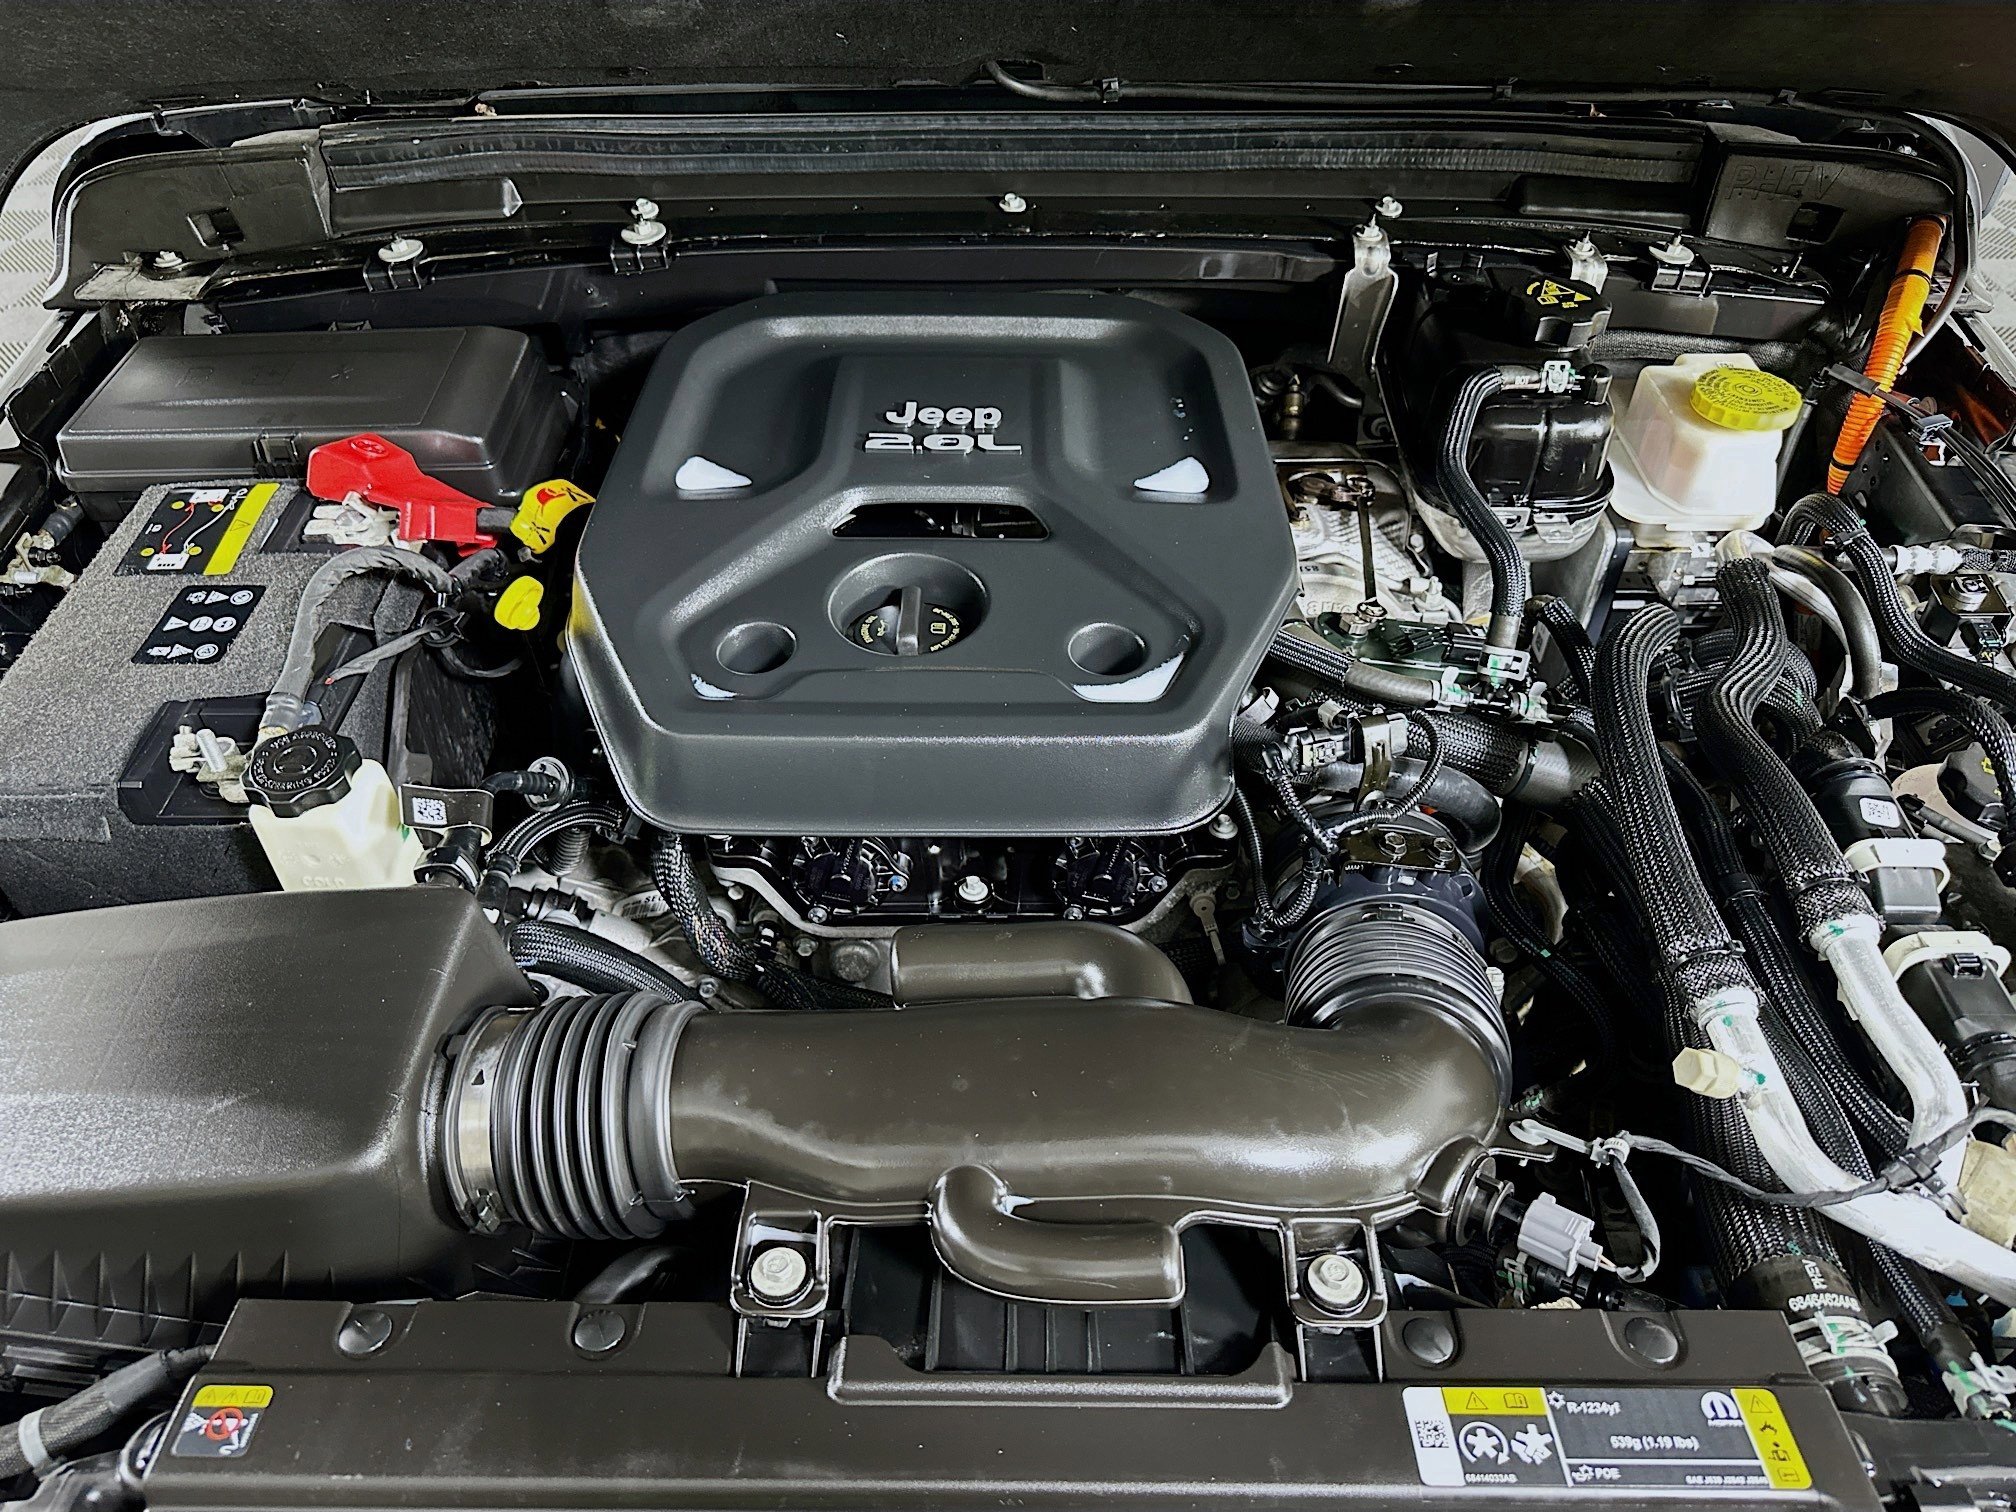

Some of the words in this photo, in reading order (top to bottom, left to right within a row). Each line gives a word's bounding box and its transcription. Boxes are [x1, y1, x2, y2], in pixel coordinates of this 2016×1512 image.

[1724, 164, 1847, 200] PHEV
[885, 401, 1002, 430] Jeep
[865, 432, 1022, 454] 2.0L
[1802, 1259, 1828, 1290] PHEV
[1566, 1401, 1621, 1416] R-1234yf
[1594, 1467, 1621, 1480] POE
